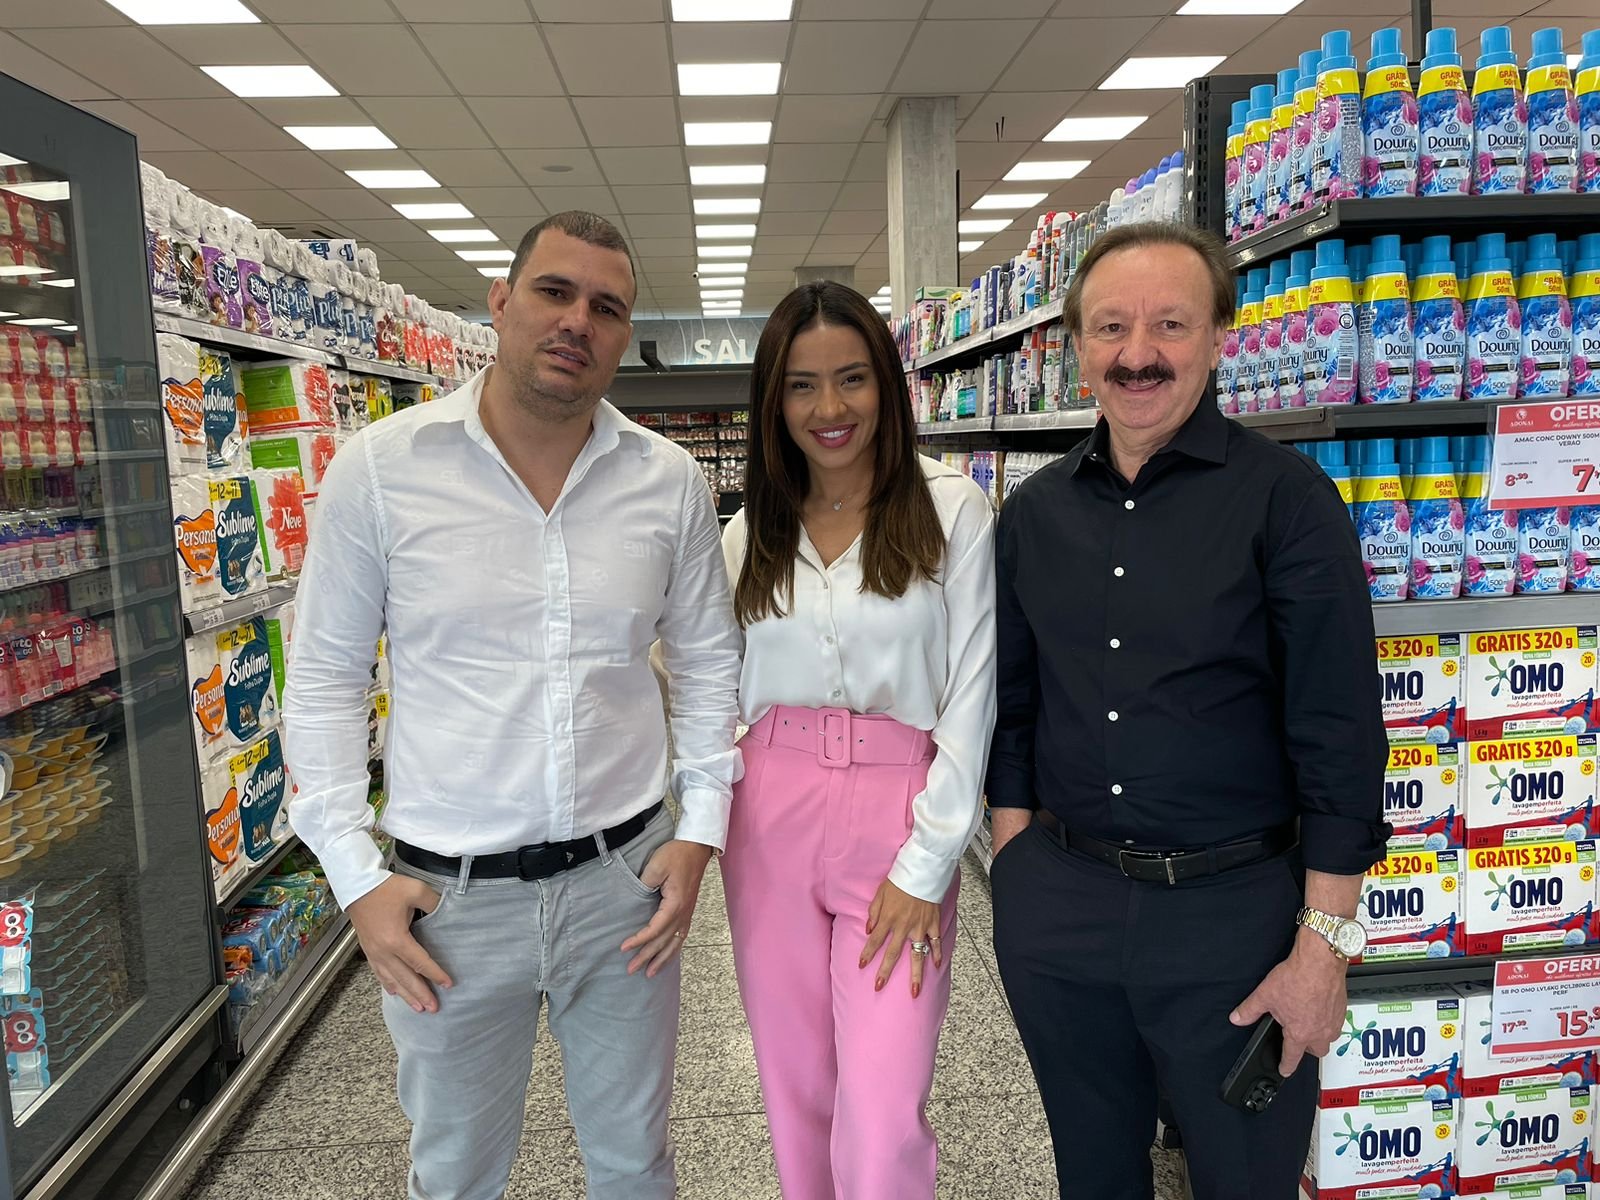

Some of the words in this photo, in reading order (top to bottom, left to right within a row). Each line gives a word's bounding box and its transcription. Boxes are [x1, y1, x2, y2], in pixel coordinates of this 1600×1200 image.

[1374, 138, 1417, 152] Downy
[1428, 136, 1470, 151] Downy
[1488, 134, 1526, 149] Downy
[1539, 134, 1578, 148] Downy
[694, 339, 754, 365] SAL
[1385, 343, 1413, 355] Down
[1426, 342, 1465, 358] Downy
[1479, 340, 1520, 355] Downy
[1531, 339, 1571, 354] Downy
[162, 384, 204, 413] Persona
[204, 388, 235, 412] ublime
[1550, 405, 1600, 421] OFER
[217, 483, 225, 499] 12
[217, 510, 256, 538] Sublime
[280, 507, 302, 531] Neve
[174, 525, 217, 548] Persona
[1529, 537, 1568, 552] Downy
[1367, 543, 1408, 559] Downy
[1422, 541, 1463, 556] Downy
[1475, 539, 1516, 555] Downy
[230, 631, 239, 647] 12
[1393, 639, 1422, 658] 320
[1426, 645, 1434, 657] g
[1476, 633, 1531, 653] GRÁTIS
[1535, 631, 1563, 649] 320
[1566, 637, 1573, 648] g
[229, 652, 270, 687] Sublime
[1445, 664, 1454, 672] 20
[1510, 662, 1564, 694] OMO
[193, 682, 224, 712] Persona
[1382, 701, 1422, 709] gemperfeita
[244, 750, 253, 768] 12
[259, 741, 265, 758] 11
[1392, 748, 1422, 767] 320
[1425, 754, 1432, 766] g
[1477, 742, 1531, 762] GRÁTIS
[1535, 740, 1563, 758] 320
[1566, 746, 1573, 757] g
[242, 765, 283, 808] Sublime
[1385, 780, 1423, 810] MO
[1511, 771, 1564, 803] OMO
[207, 806, 240, 842] Persona
[1392, 856, 1422, 875] 320
[1425, 862, 1433, 873] g
[1475, 848, 1530, 868] GRÁTIS
[1533, 846, 1562, 864] 320
[1565, 852, 1572, 863] g
[1445, 880, 1453, 888] 20
[1509, 877, 1563, 909] OMO
[1368, 887, 1424, 919] OMO
[1544, 958, 1600, 974] OFERT
[1444, 1027, 1452, 1035] 20
[1557, 1006, 1600, 1037] 15,9
[1361, 1026, 1426, 1060] OMO
[1576, 1113, 1584, 1121] 20
[1500, 1114, 1560, 1148] OMO
[1359, 1126, 1421, 1161] OMO
